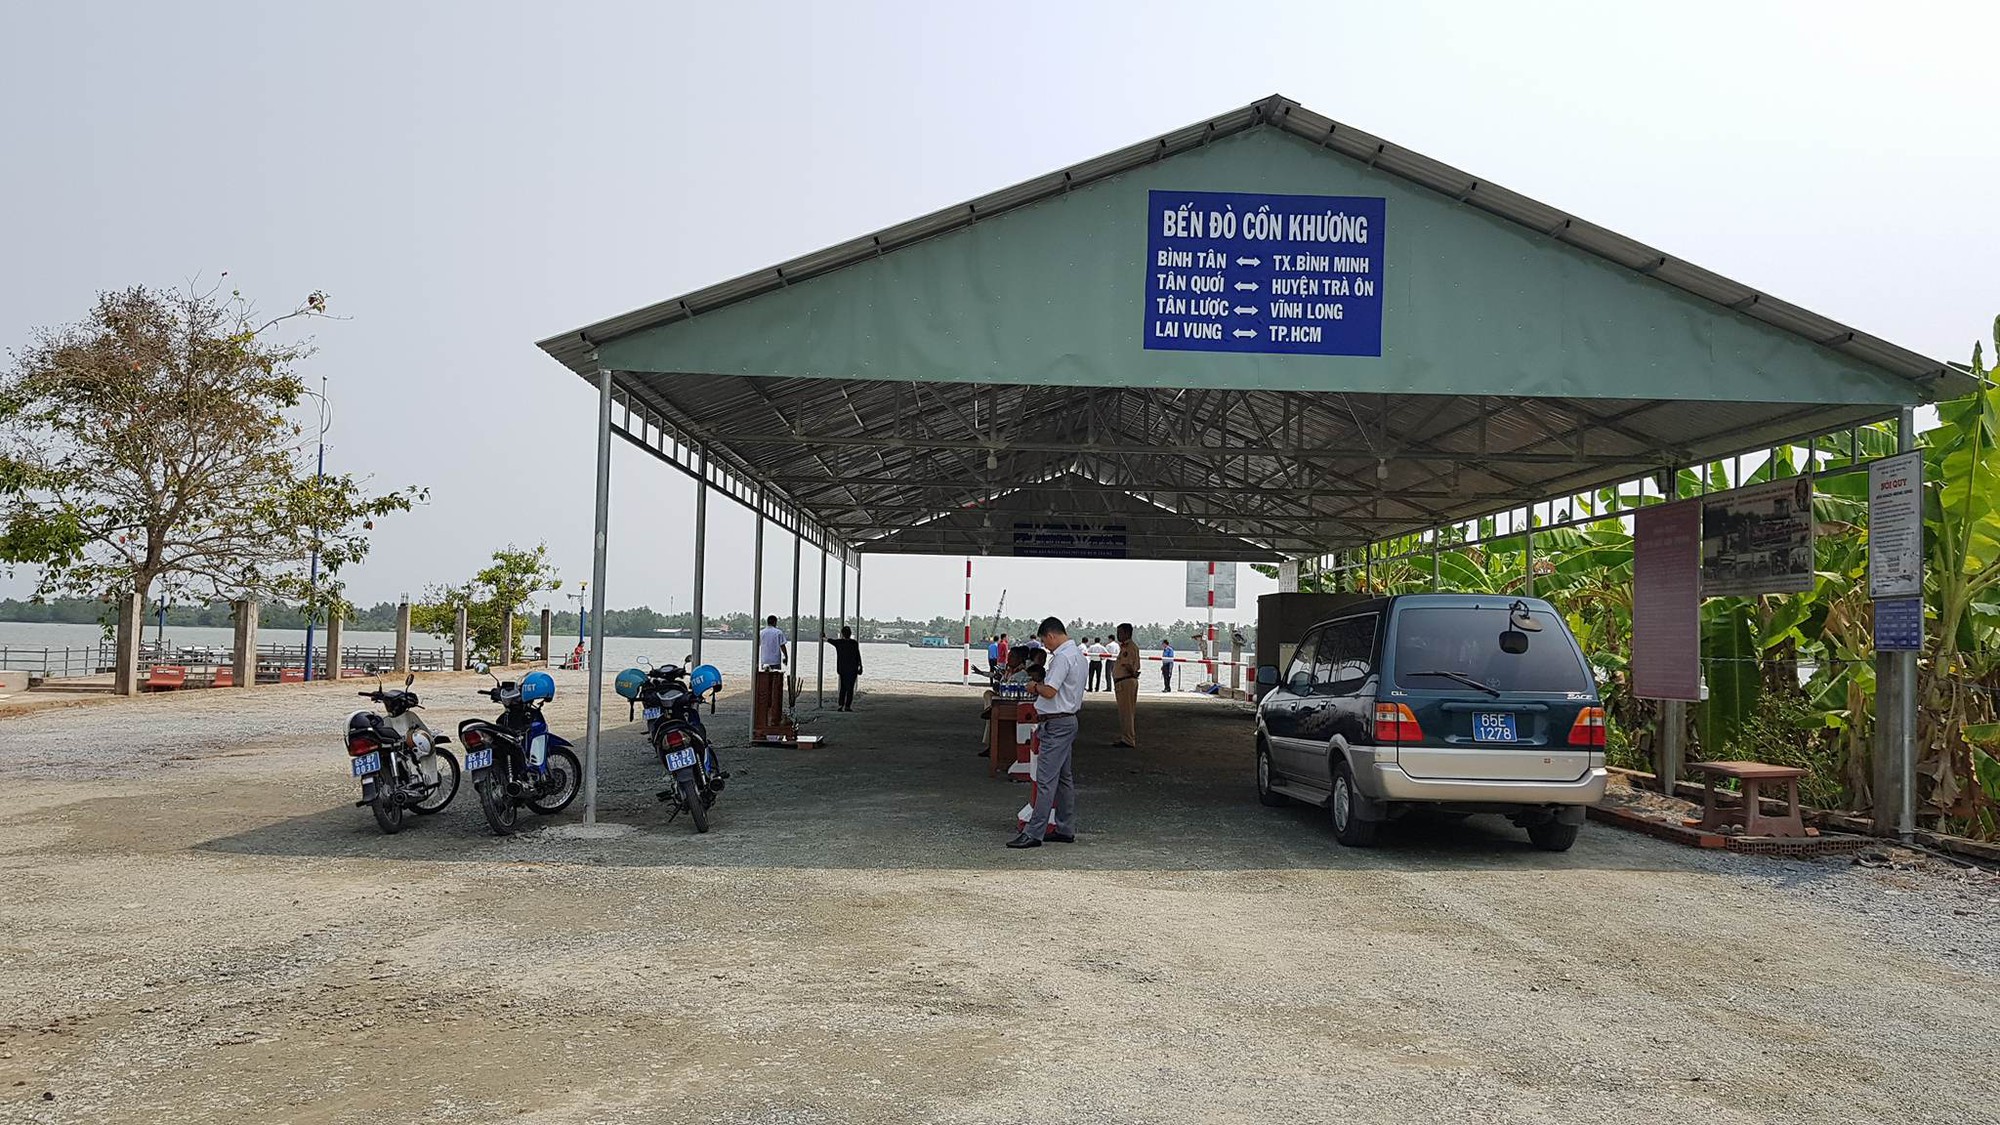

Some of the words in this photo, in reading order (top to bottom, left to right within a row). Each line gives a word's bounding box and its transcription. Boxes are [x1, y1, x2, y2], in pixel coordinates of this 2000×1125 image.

[1163, 202, 1203, 238] BẾN
[1209, 205, 1236, 239] ĐÒ
[1243, 205, 1282, 241] CỒN
[1288, 210, 1368, 244] KHƯƠNG
[1157, 247, 1192, 268] BÌNH
[1197, 249, 1227, 269] TÂN
[1273, 252, 1329, 273] TX.BÌNH
[1333, 257, 1369, 273] MINH
[1157, 273, 1186, 291] TÂN
[1190, 271, 1225, 294] QUỚI
[1272, 275, 1319, 298] HUYỆN
[1322, 276, 1349, 296] TRÀ
[1354, 277, 1374, 297] ÔN
[1157, 297, 1186, 315] TÂN
[1190, 297, 1229, 319] LƯỢC
[1270, 298, 1302, 319] VĨNH
[1307, 303, 1343, 320] LONG
[1155, 320, 1179, 338] LAI
[1183, 322, 1222, 340] VUNG
[1269, 325, 1322, 343] TP.HCM
[1481, 714, 1506, 727] 65E
[1480, 727, 1511, 740] 1278
[355, 761, 376, 775] 0031
[468, 757, 488, 770] 0036
